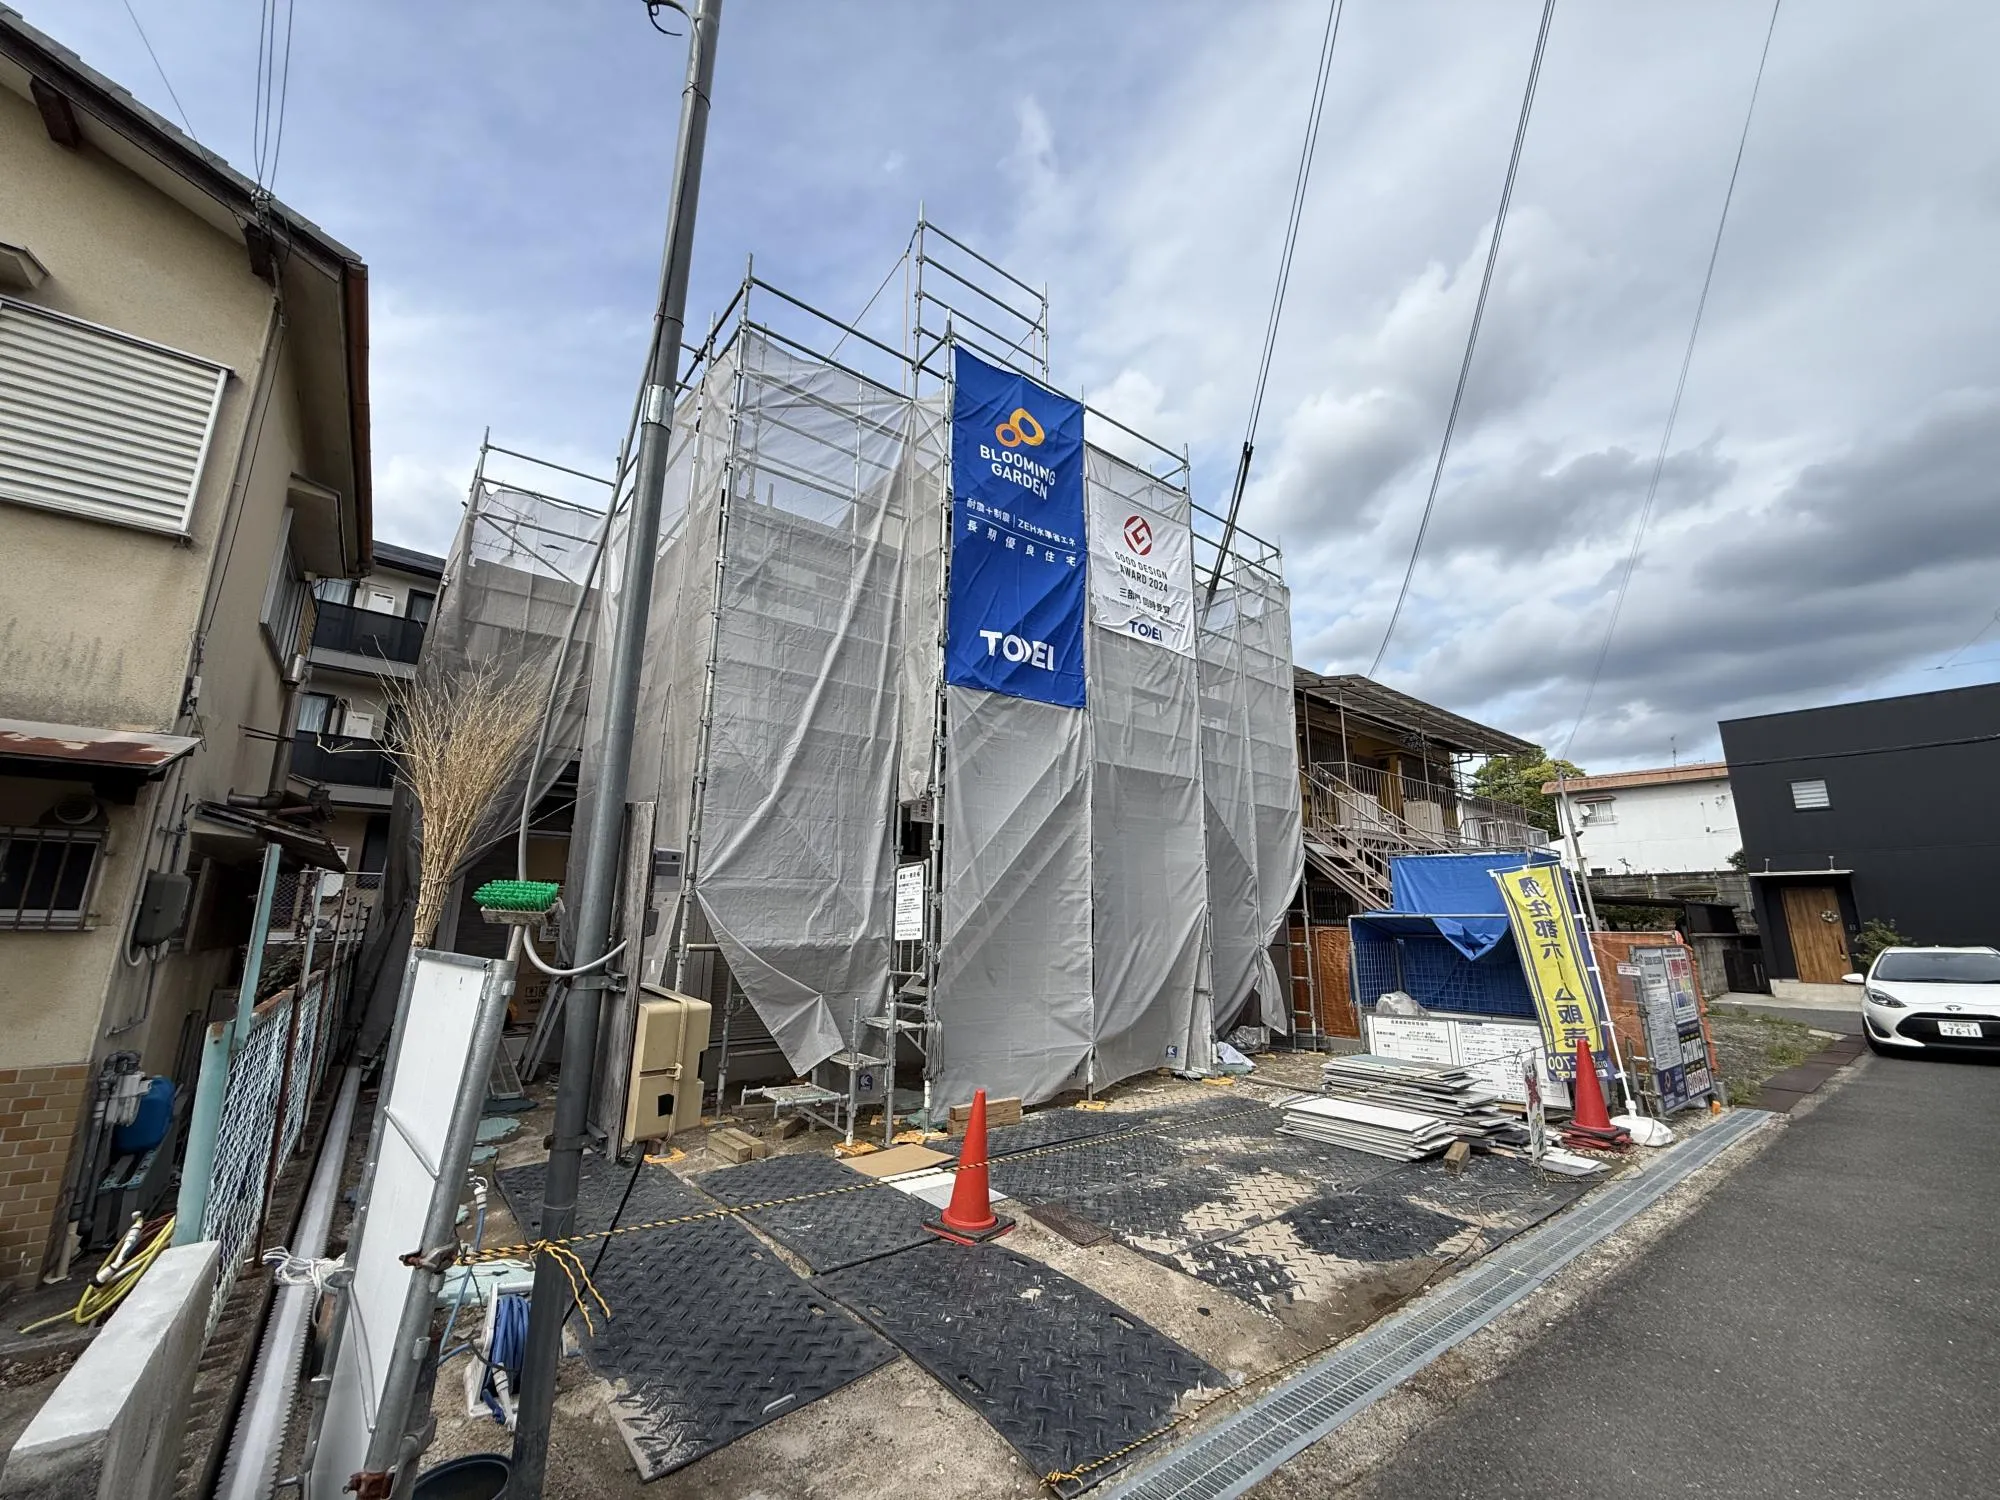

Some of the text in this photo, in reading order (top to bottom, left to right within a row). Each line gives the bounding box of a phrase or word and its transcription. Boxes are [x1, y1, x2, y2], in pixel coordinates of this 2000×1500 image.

[980, 444, 1056, 486] BLOOMING
[991, 462, 1048, 500] GARDEN
[967, 519, 1076, 567] 長期優良住宅
[1114, 551, 1168, 580] GOOD DESIGN
[1120, 564, 1168, 592] AWARD 2024
